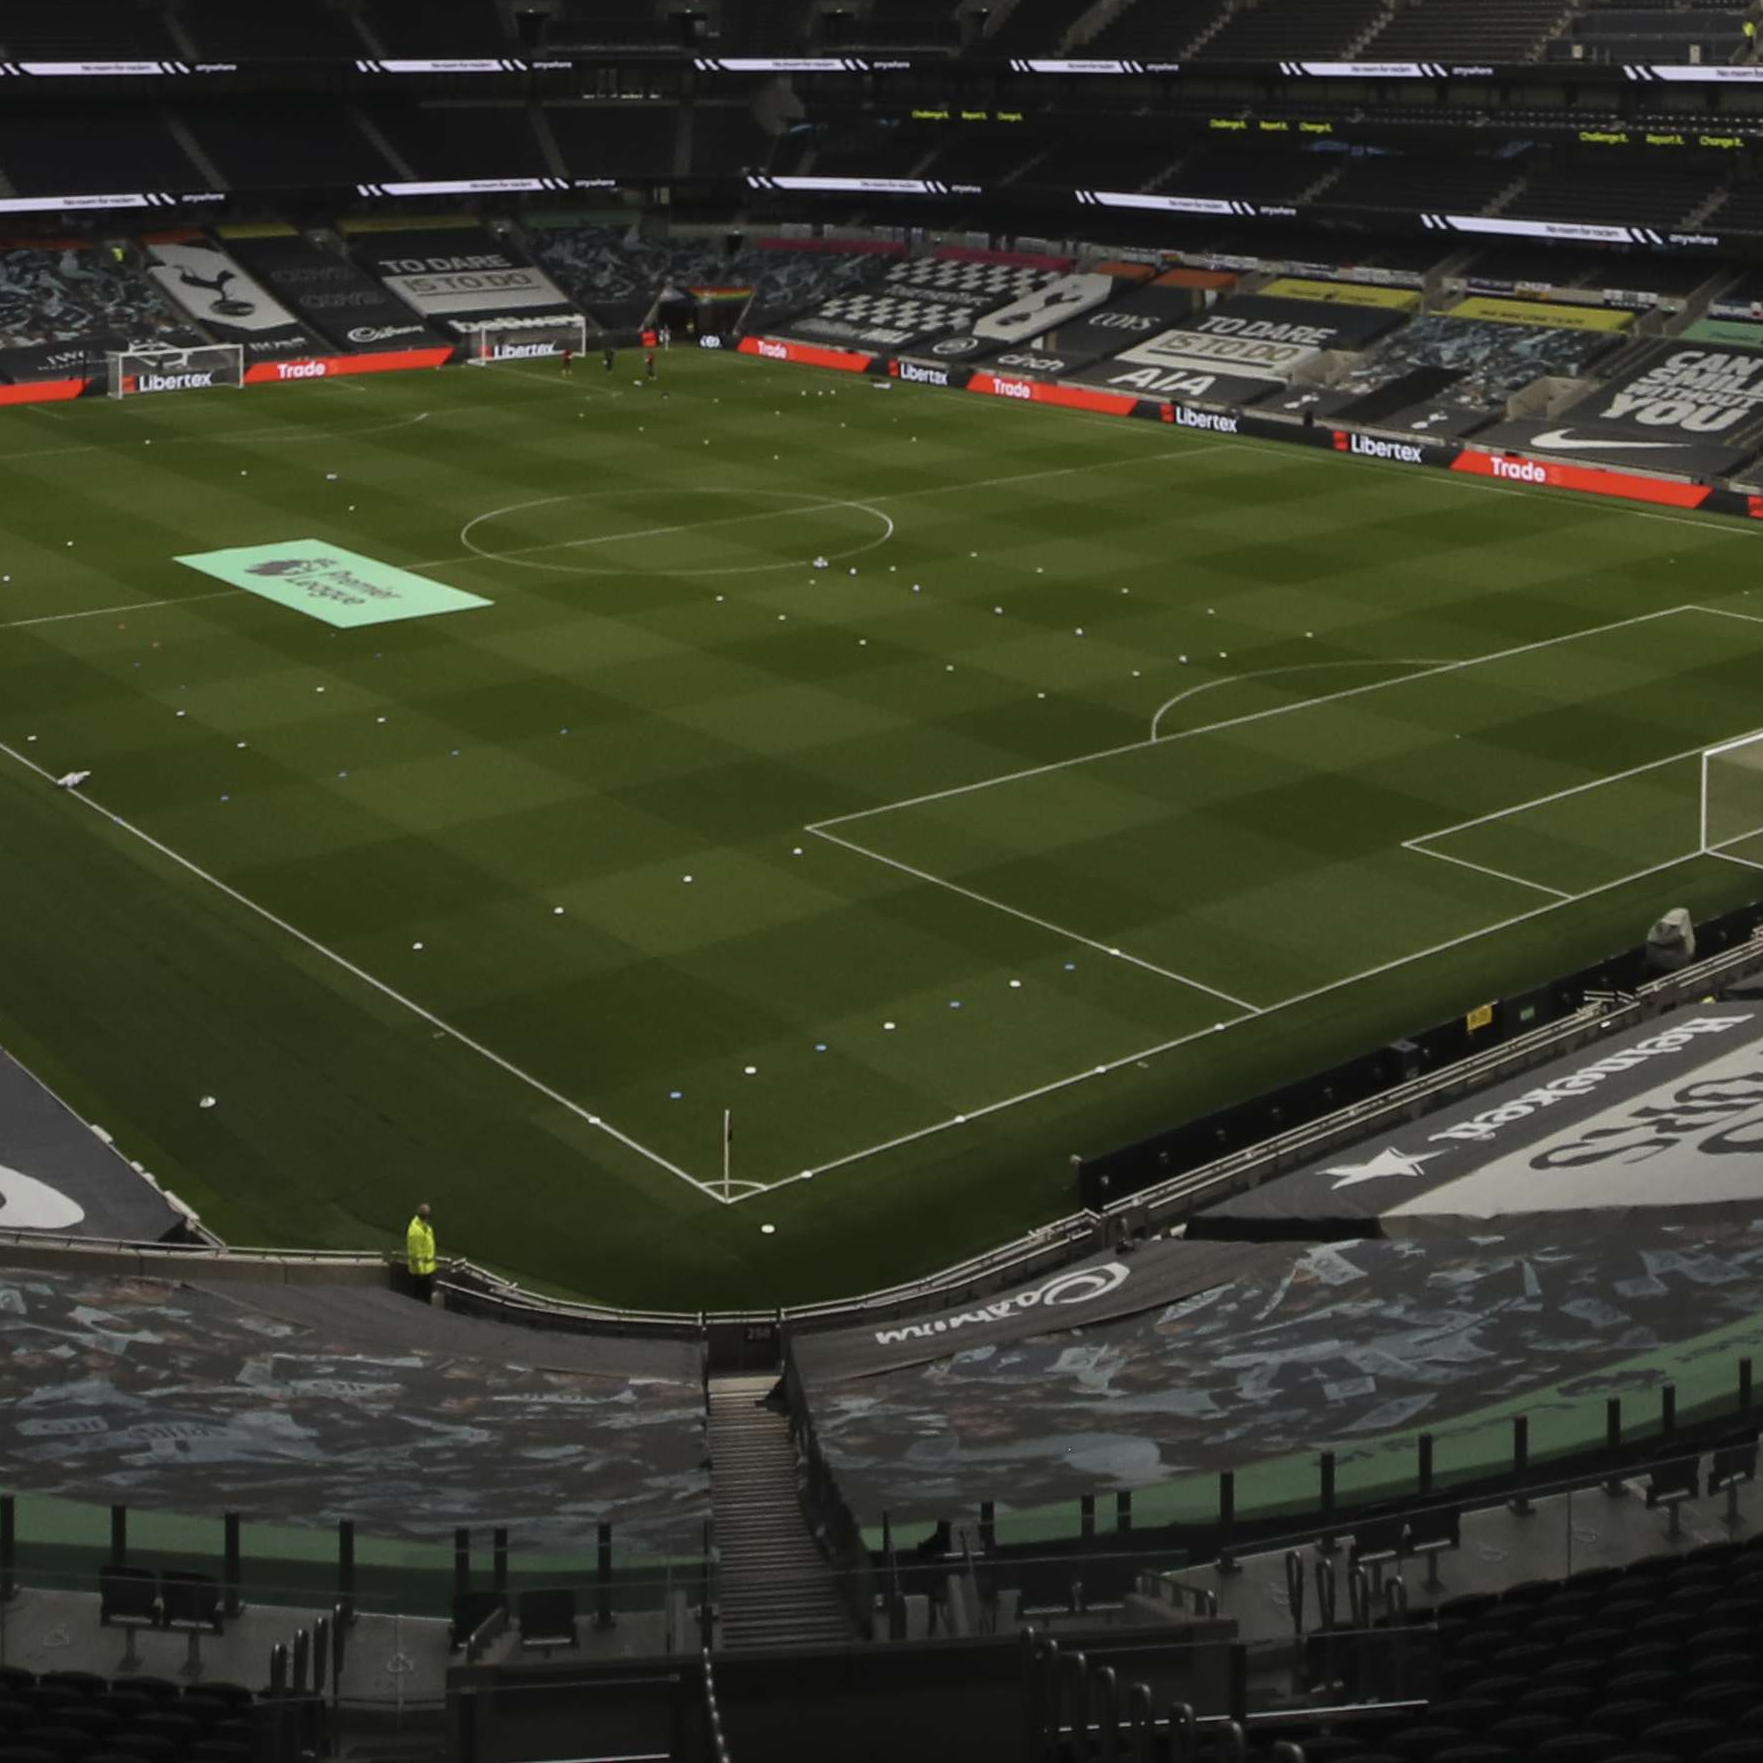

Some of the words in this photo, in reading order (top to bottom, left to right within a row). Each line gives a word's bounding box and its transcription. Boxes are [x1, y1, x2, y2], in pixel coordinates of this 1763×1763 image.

[379, 258, 429, 275] TO
[431, 254, 512, 272] DARE
[402, 277, 432, 293] IS
[438, 275, 484, 290] TO
[489, 272, 532, 287] DO
[1197, 316, 1247, 334] TO
[1238, 320, 1338, 345] DARE
[757, 340, 788, 359] Trade
[1160, 335, 1200, 350] IS
[1196, 338, 1244, 354] TO
[1241, 342, 1299, 360] DO
[138, 371, 214, 393] Libertex
[276, 361, 326, 379] Trade
[900, 362, 950, 386] Libertex
[1107, 368, 1216, 397] AIA
[993, 378, 1031, 399] Trade
[1175, 407, 1238, 434] Libertex
[1598, 392, 1750, 432] YOU
[1350, 433, 1423, 464] Libertex
[1489, 456, 1547, 483] Trade
[1429, 1012, 1755, 1144] Heineken
